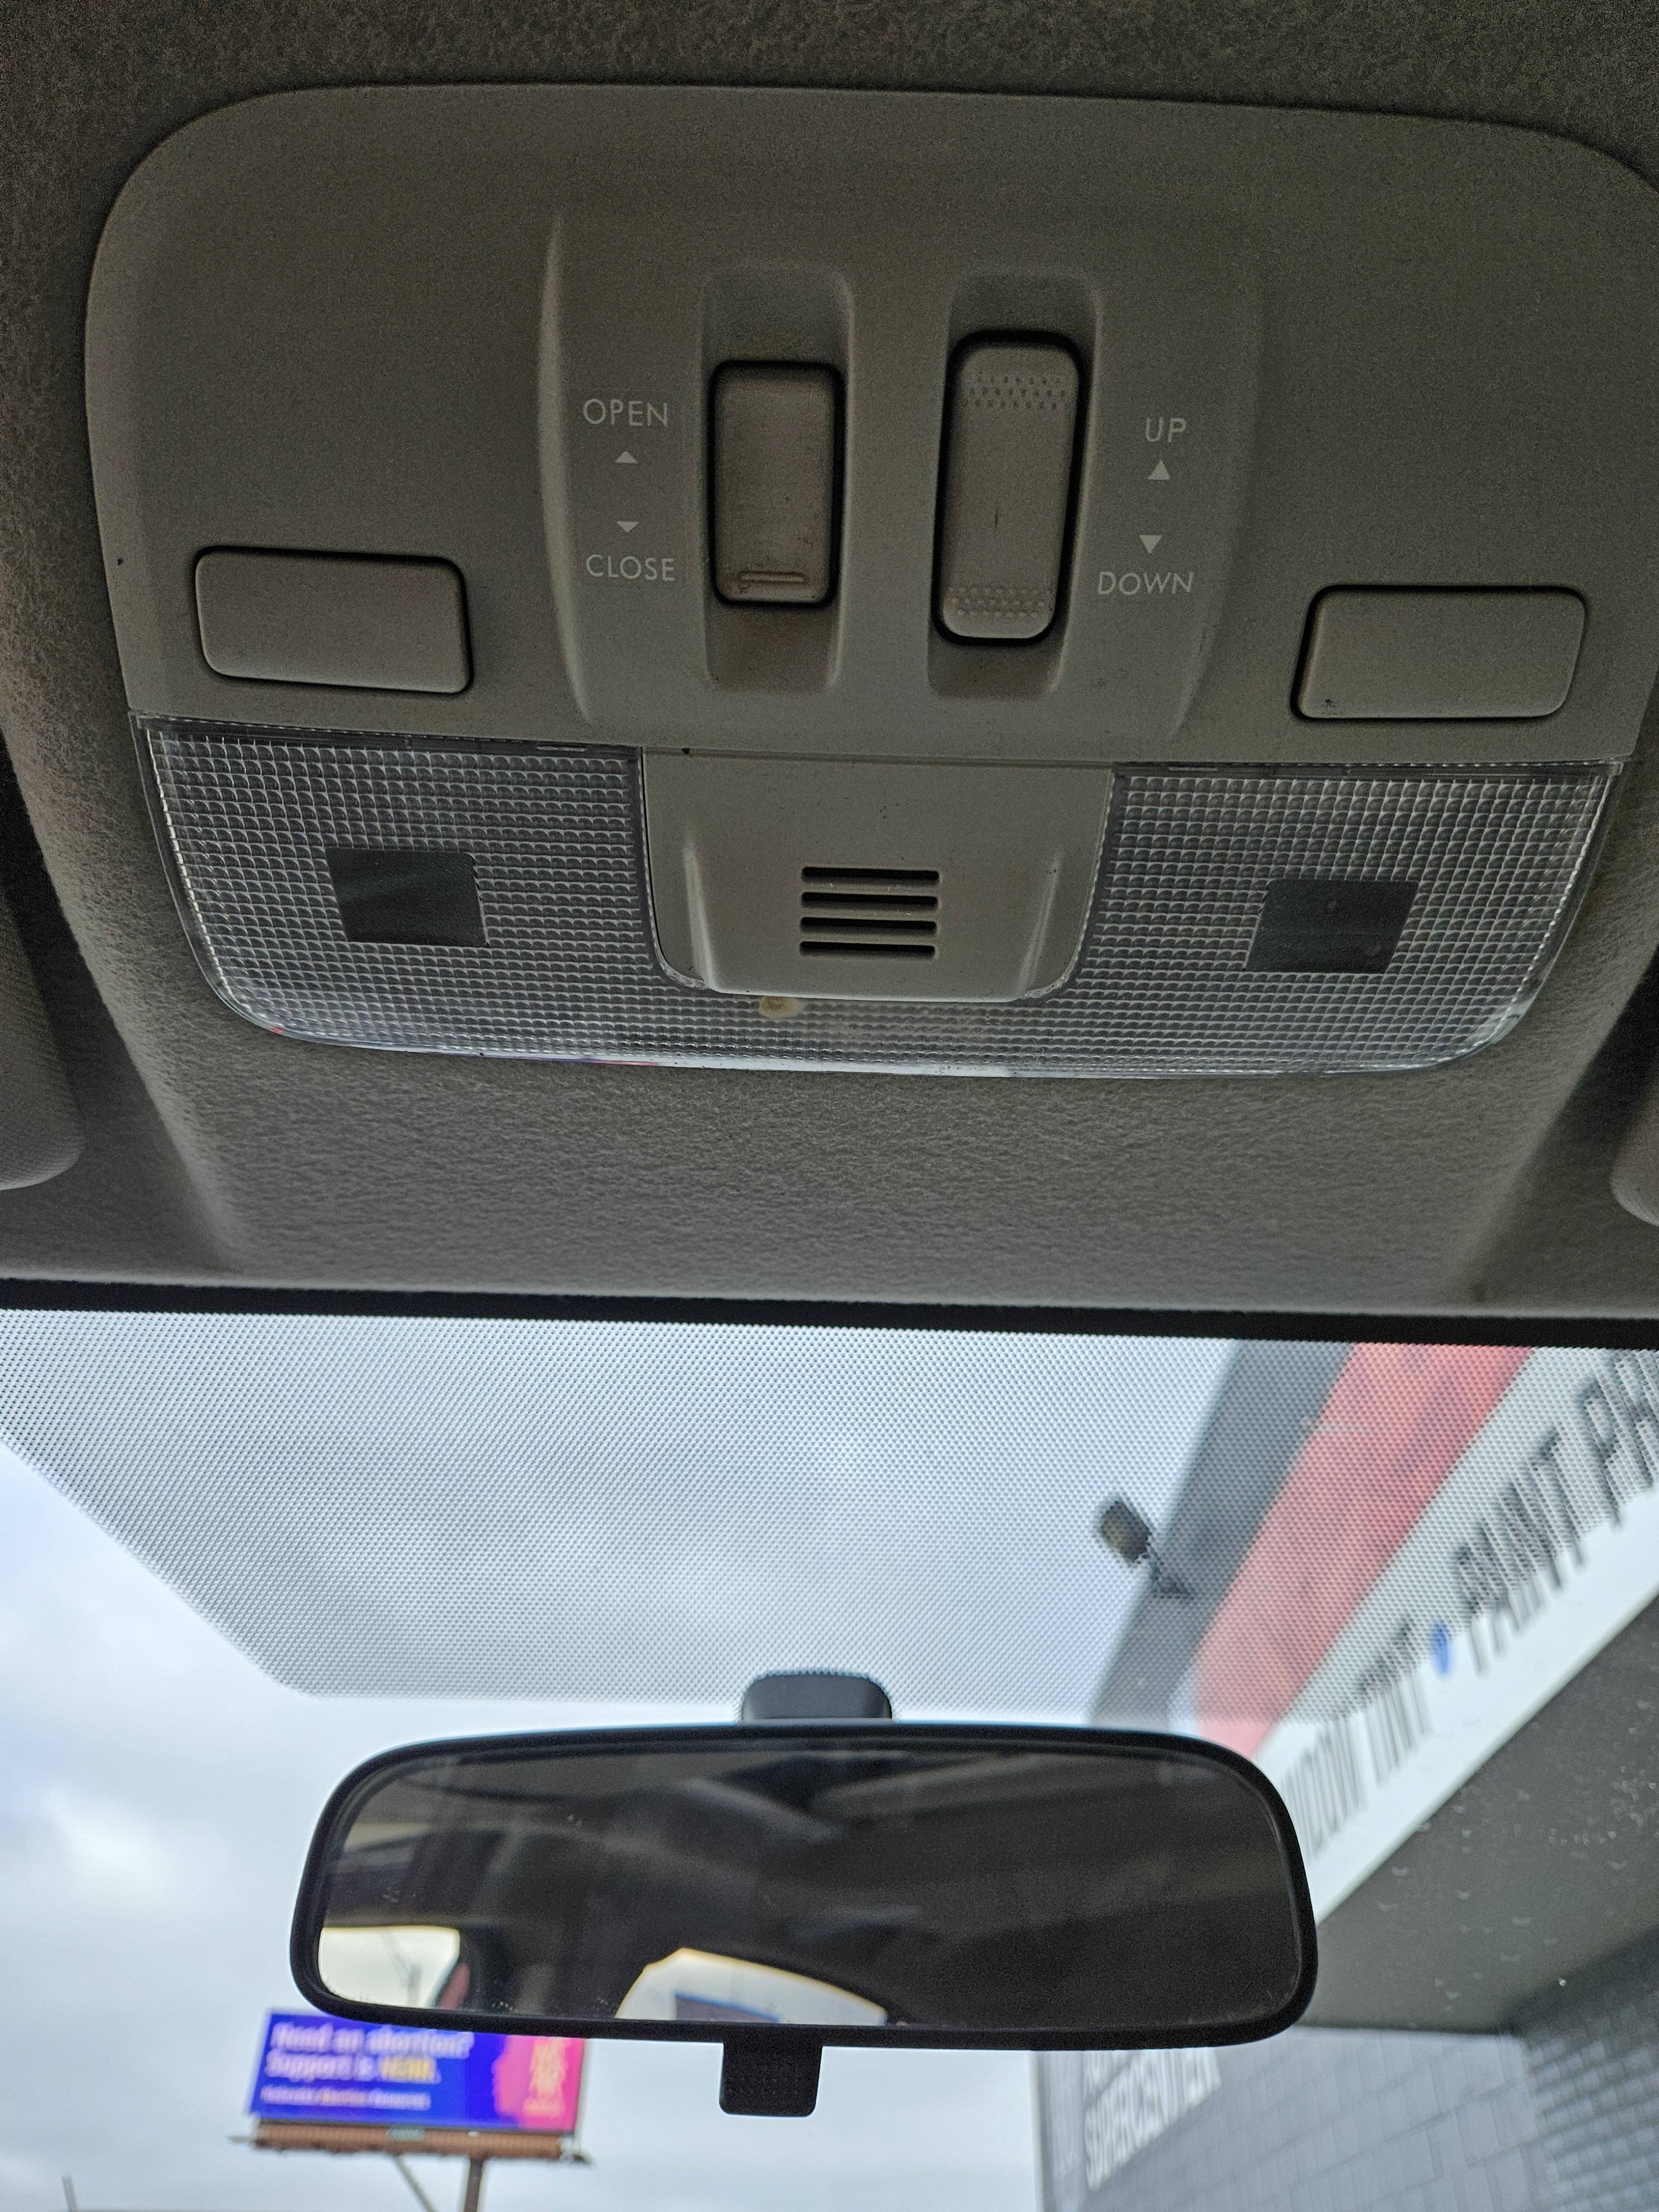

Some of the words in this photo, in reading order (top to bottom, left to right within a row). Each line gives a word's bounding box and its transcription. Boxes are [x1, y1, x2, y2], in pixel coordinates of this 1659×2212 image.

[582, 398, 669, 427] OPEN
[1145, 417, 1187, 442] UP
[586, 554, 676, 582] CLOSE
[1097, 571, 1194, 596] DOWN
